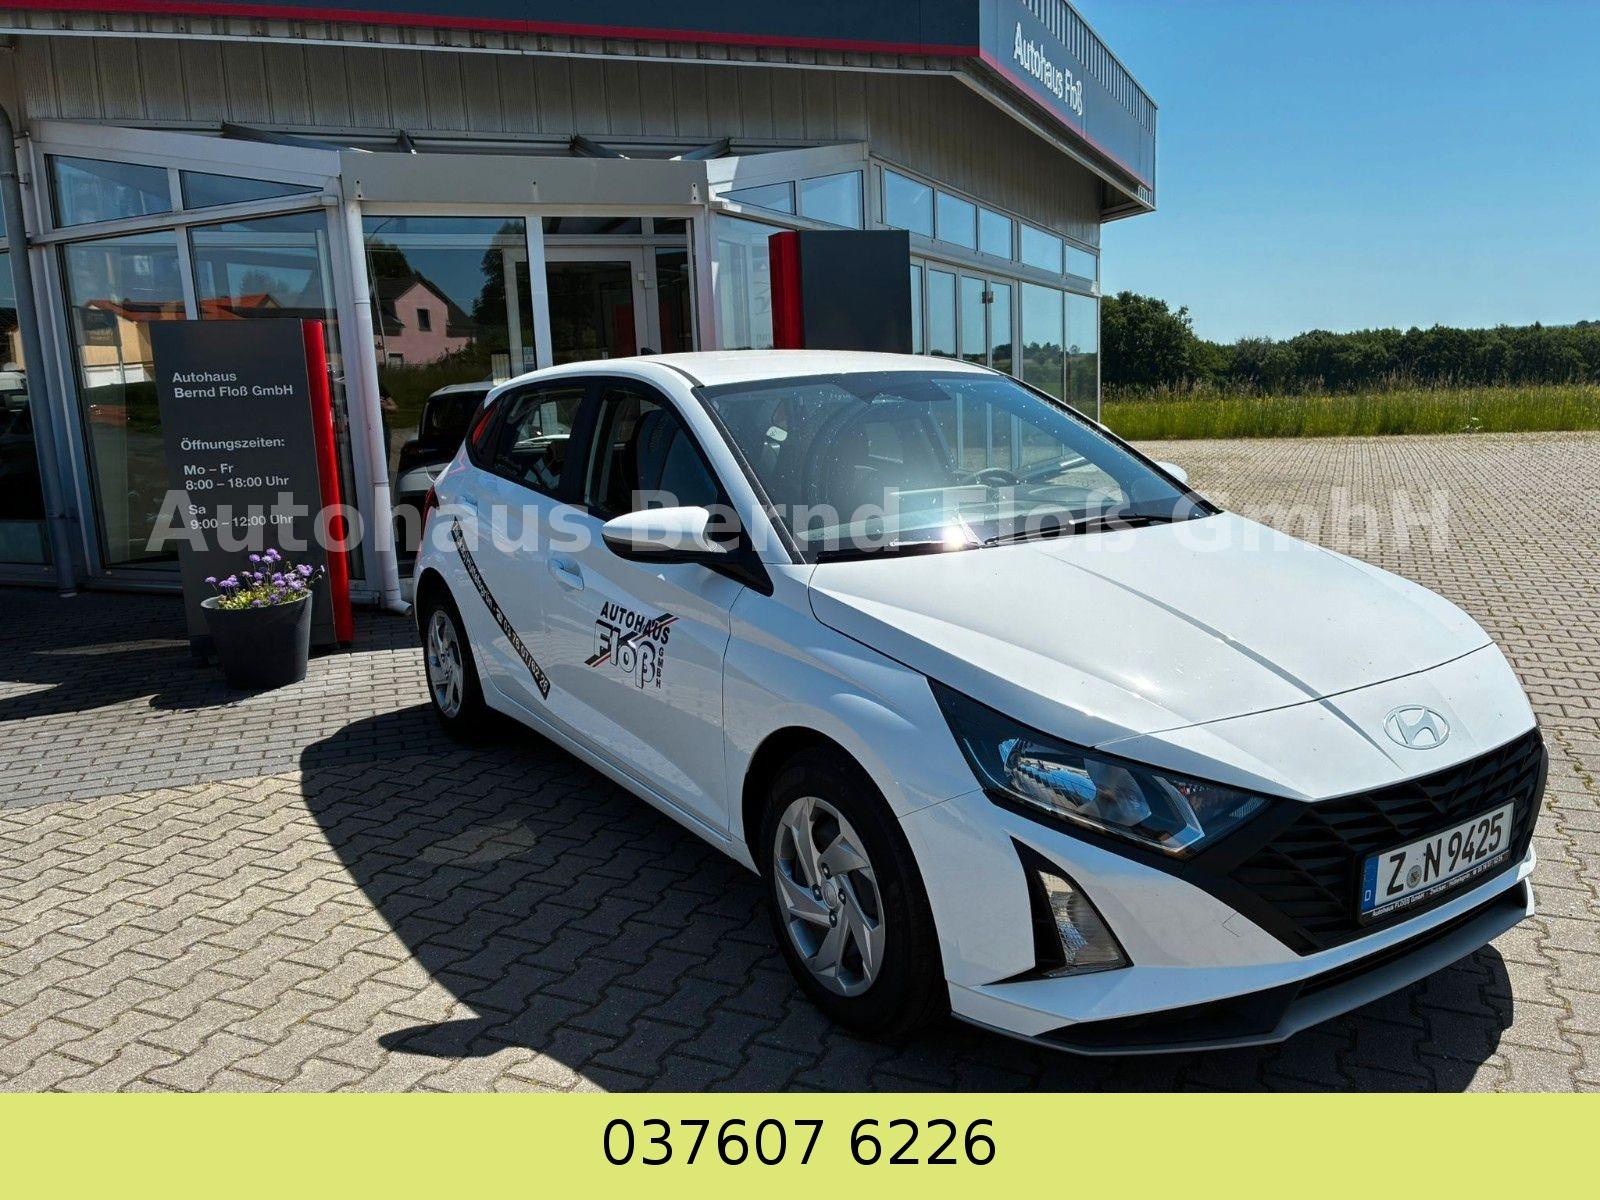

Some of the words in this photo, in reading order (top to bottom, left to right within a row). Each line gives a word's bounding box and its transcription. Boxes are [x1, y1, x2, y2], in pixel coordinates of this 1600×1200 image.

[1013, 21, 1063, 99] Autohaus
[172, 372, 237, 383] Autohaus
[174, 387, 216, 399] Bernd
[219, 386, 248, 398] Floß
[252, 384, 293, 397] GmbH
[180, 437, 285, 451] Öffnungszeiten:
[184, 464, 206, 476] Mo
[220, 463, 234, 474] Fr
[185, 479, 214, 491] 8:00
[228, 477, 262, 489] 18:00
[265, 476, 289, 487] Uhr
[188, 504, 207, 515] Sa
[190, 518, 218, 530] 9:00
[232, 515, 267, 527] 12:00
[270, 514, 294, 525] Uhr
[600, 601, 671, 645] AUTOHAUS
[1386, 851, 1406, 896] Z
[1423, 838, 1443, 883] N
[1449, 811, 1504, 873] 9425
[1364, 889, 1372, 902] D
